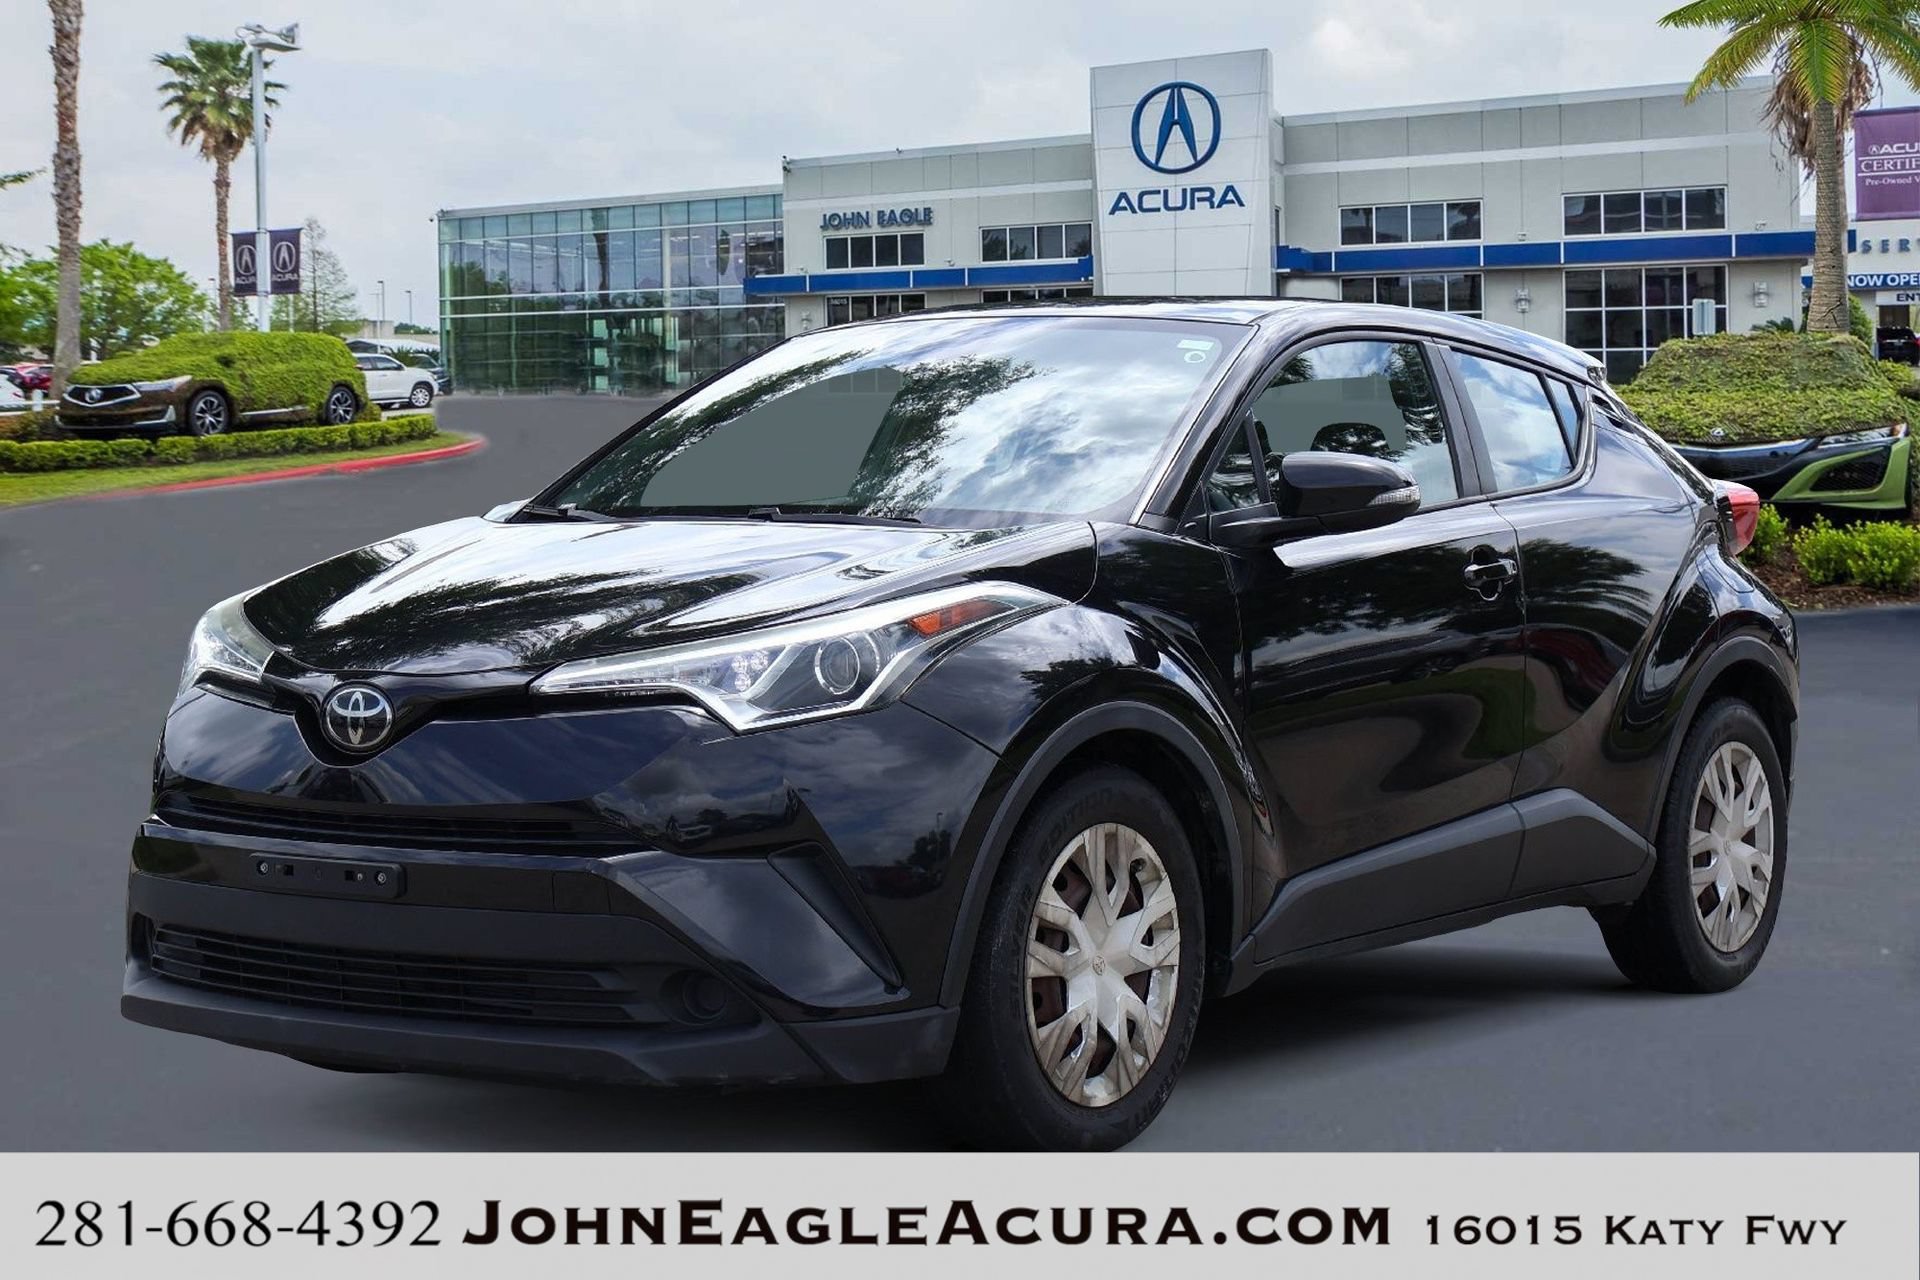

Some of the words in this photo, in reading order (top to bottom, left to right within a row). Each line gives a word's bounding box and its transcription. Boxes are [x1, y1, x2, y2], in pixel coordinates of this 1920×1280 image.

[1880, 143, 1920, 154] ACU
[1865, 176, 1912, 186] Pre-Owned
[1109, 185, 1245, 216] ACURA
[820, 211, 871, 231] JOHN
[877, 207, 934, 228] EAGLE
[1887, 273, 1920, 286] OPE
